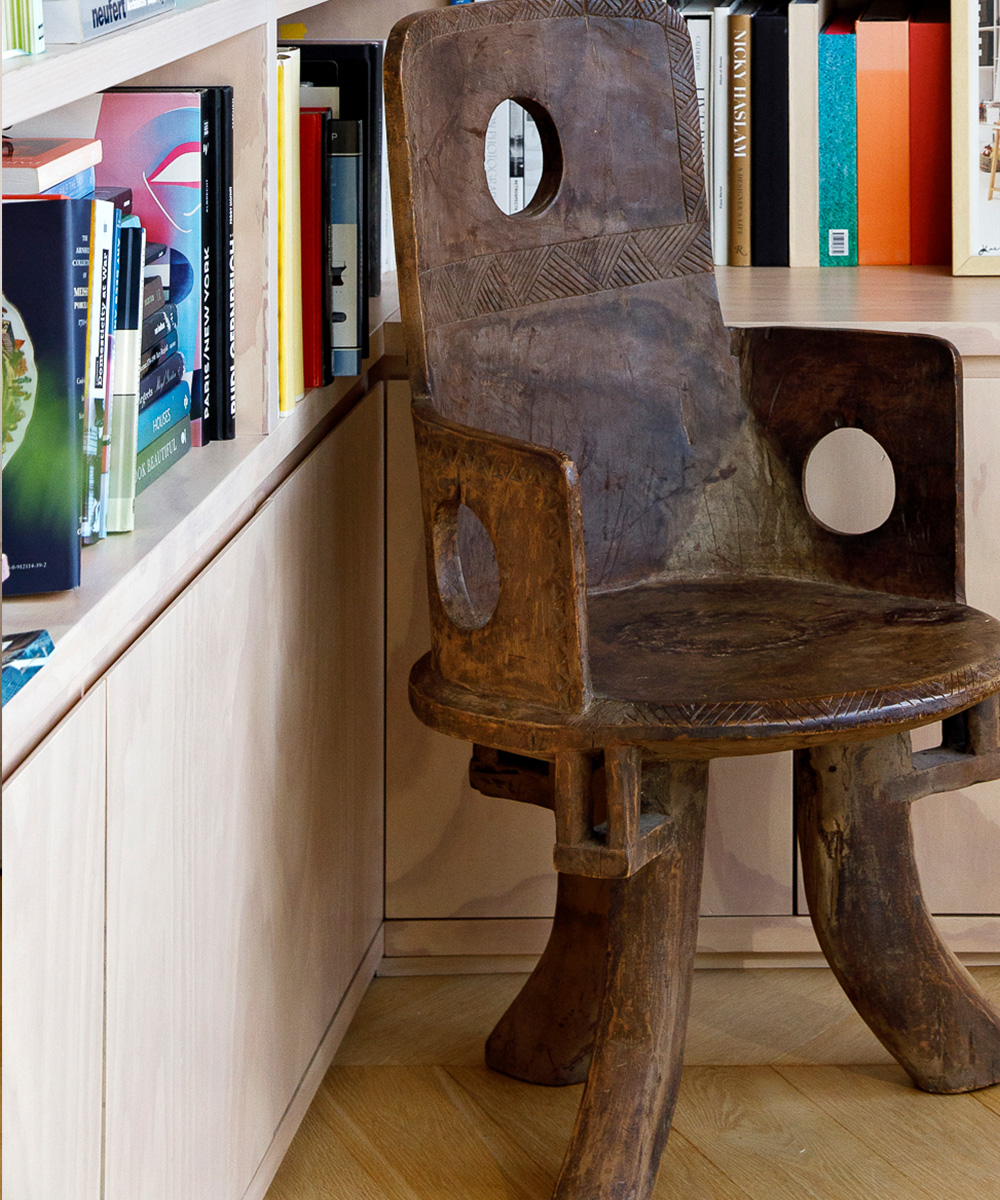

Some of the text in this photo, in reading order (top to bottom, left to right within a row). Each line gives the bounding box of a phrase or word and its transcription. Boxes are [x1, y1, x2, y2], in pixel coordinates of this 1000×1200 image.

[98, 301, 107, 386] Domesticity
[152, 408, 171, 433] HOUSES
[147, 439, 178, 472] BEAUTIFUL
